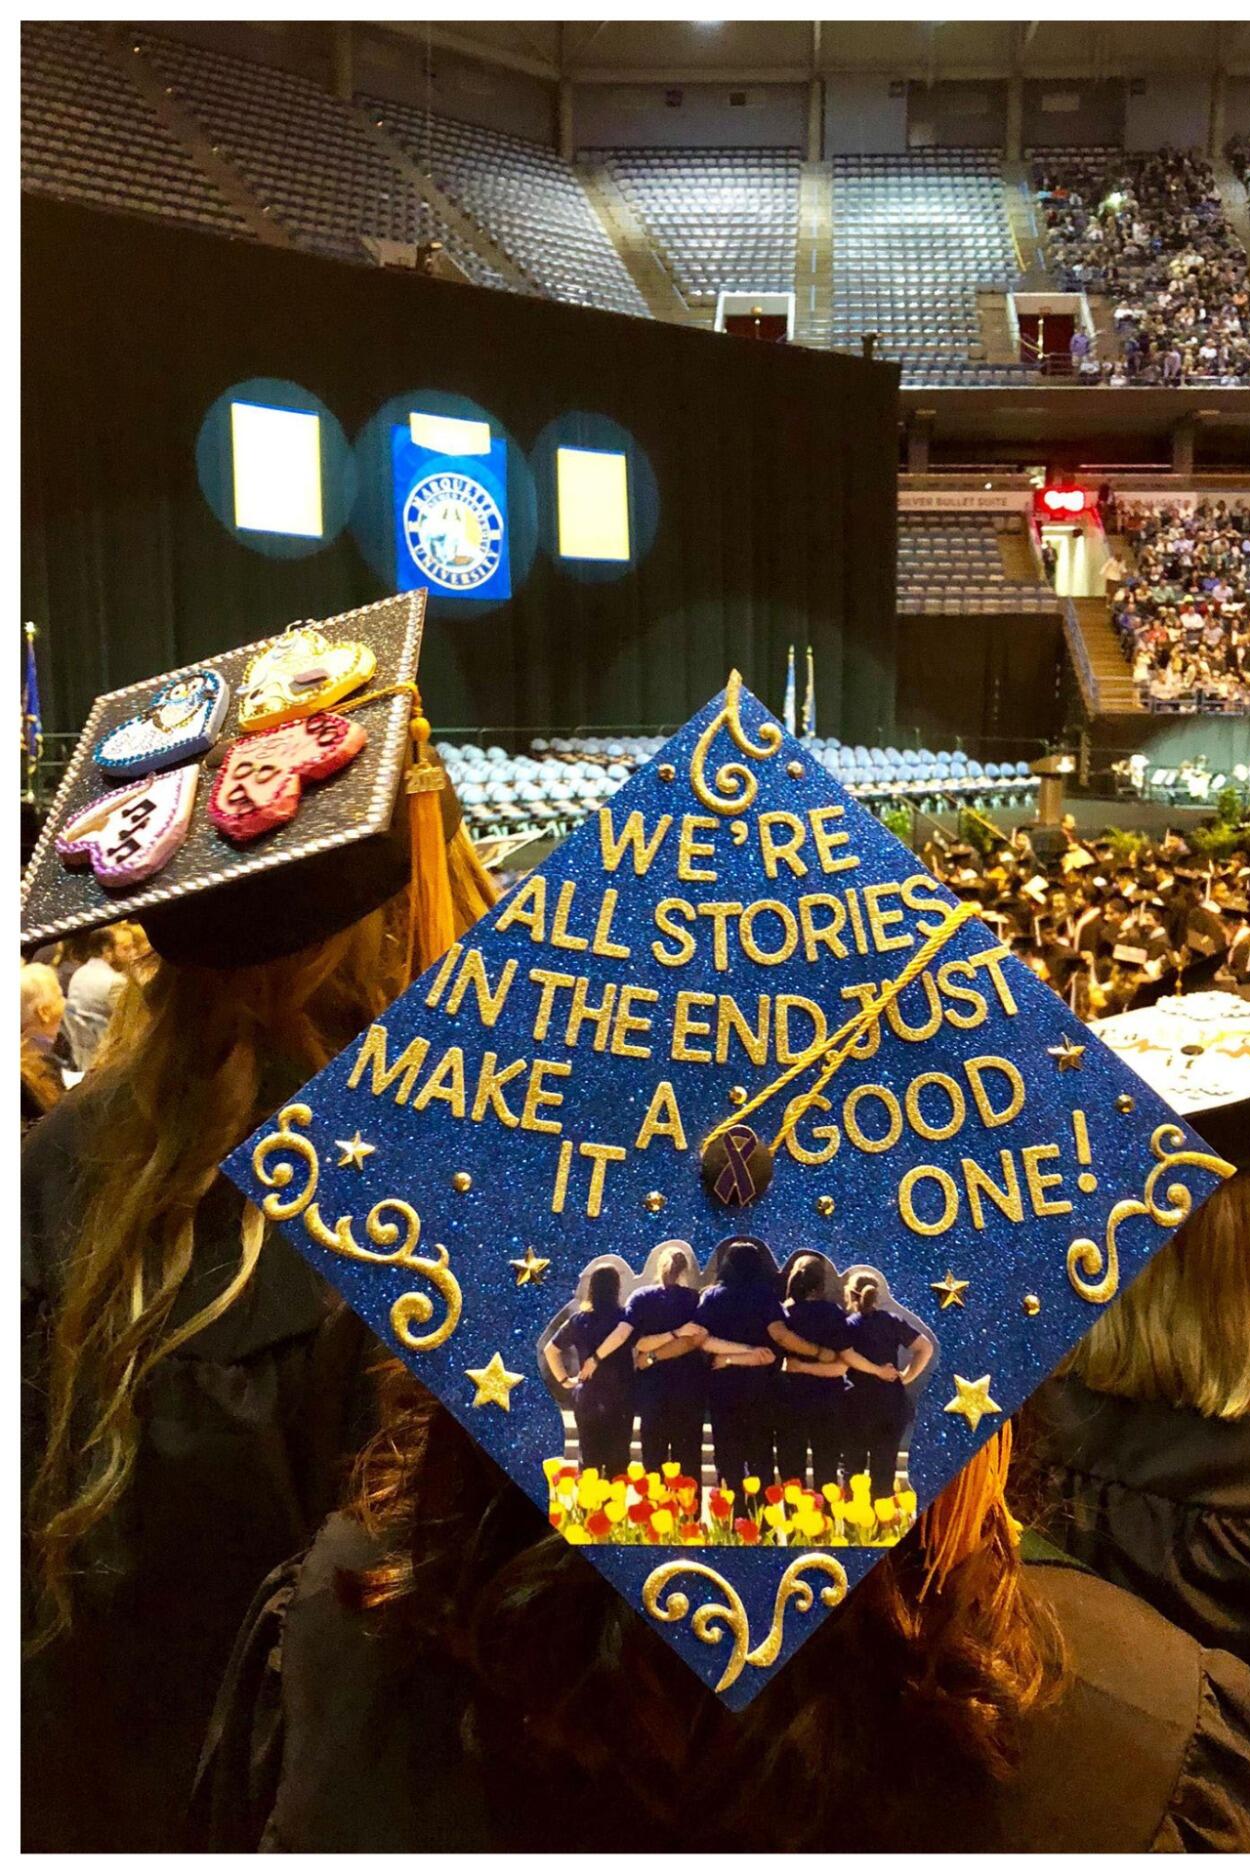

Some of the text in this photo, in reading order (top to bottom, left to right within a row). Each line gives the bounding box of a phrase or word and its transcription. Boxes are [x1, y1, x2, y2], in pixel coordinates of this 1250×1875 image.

[598, 805, 861, 881] WE'RE
[495, 875, 958, 971] ALL STORIES
[425, 942, 1018, 1066] IN THE END JUST
[346, 1024, 1026, 1165] MAKE A GOOD
[552, 1109, 1099, 1237] IT ONE!
